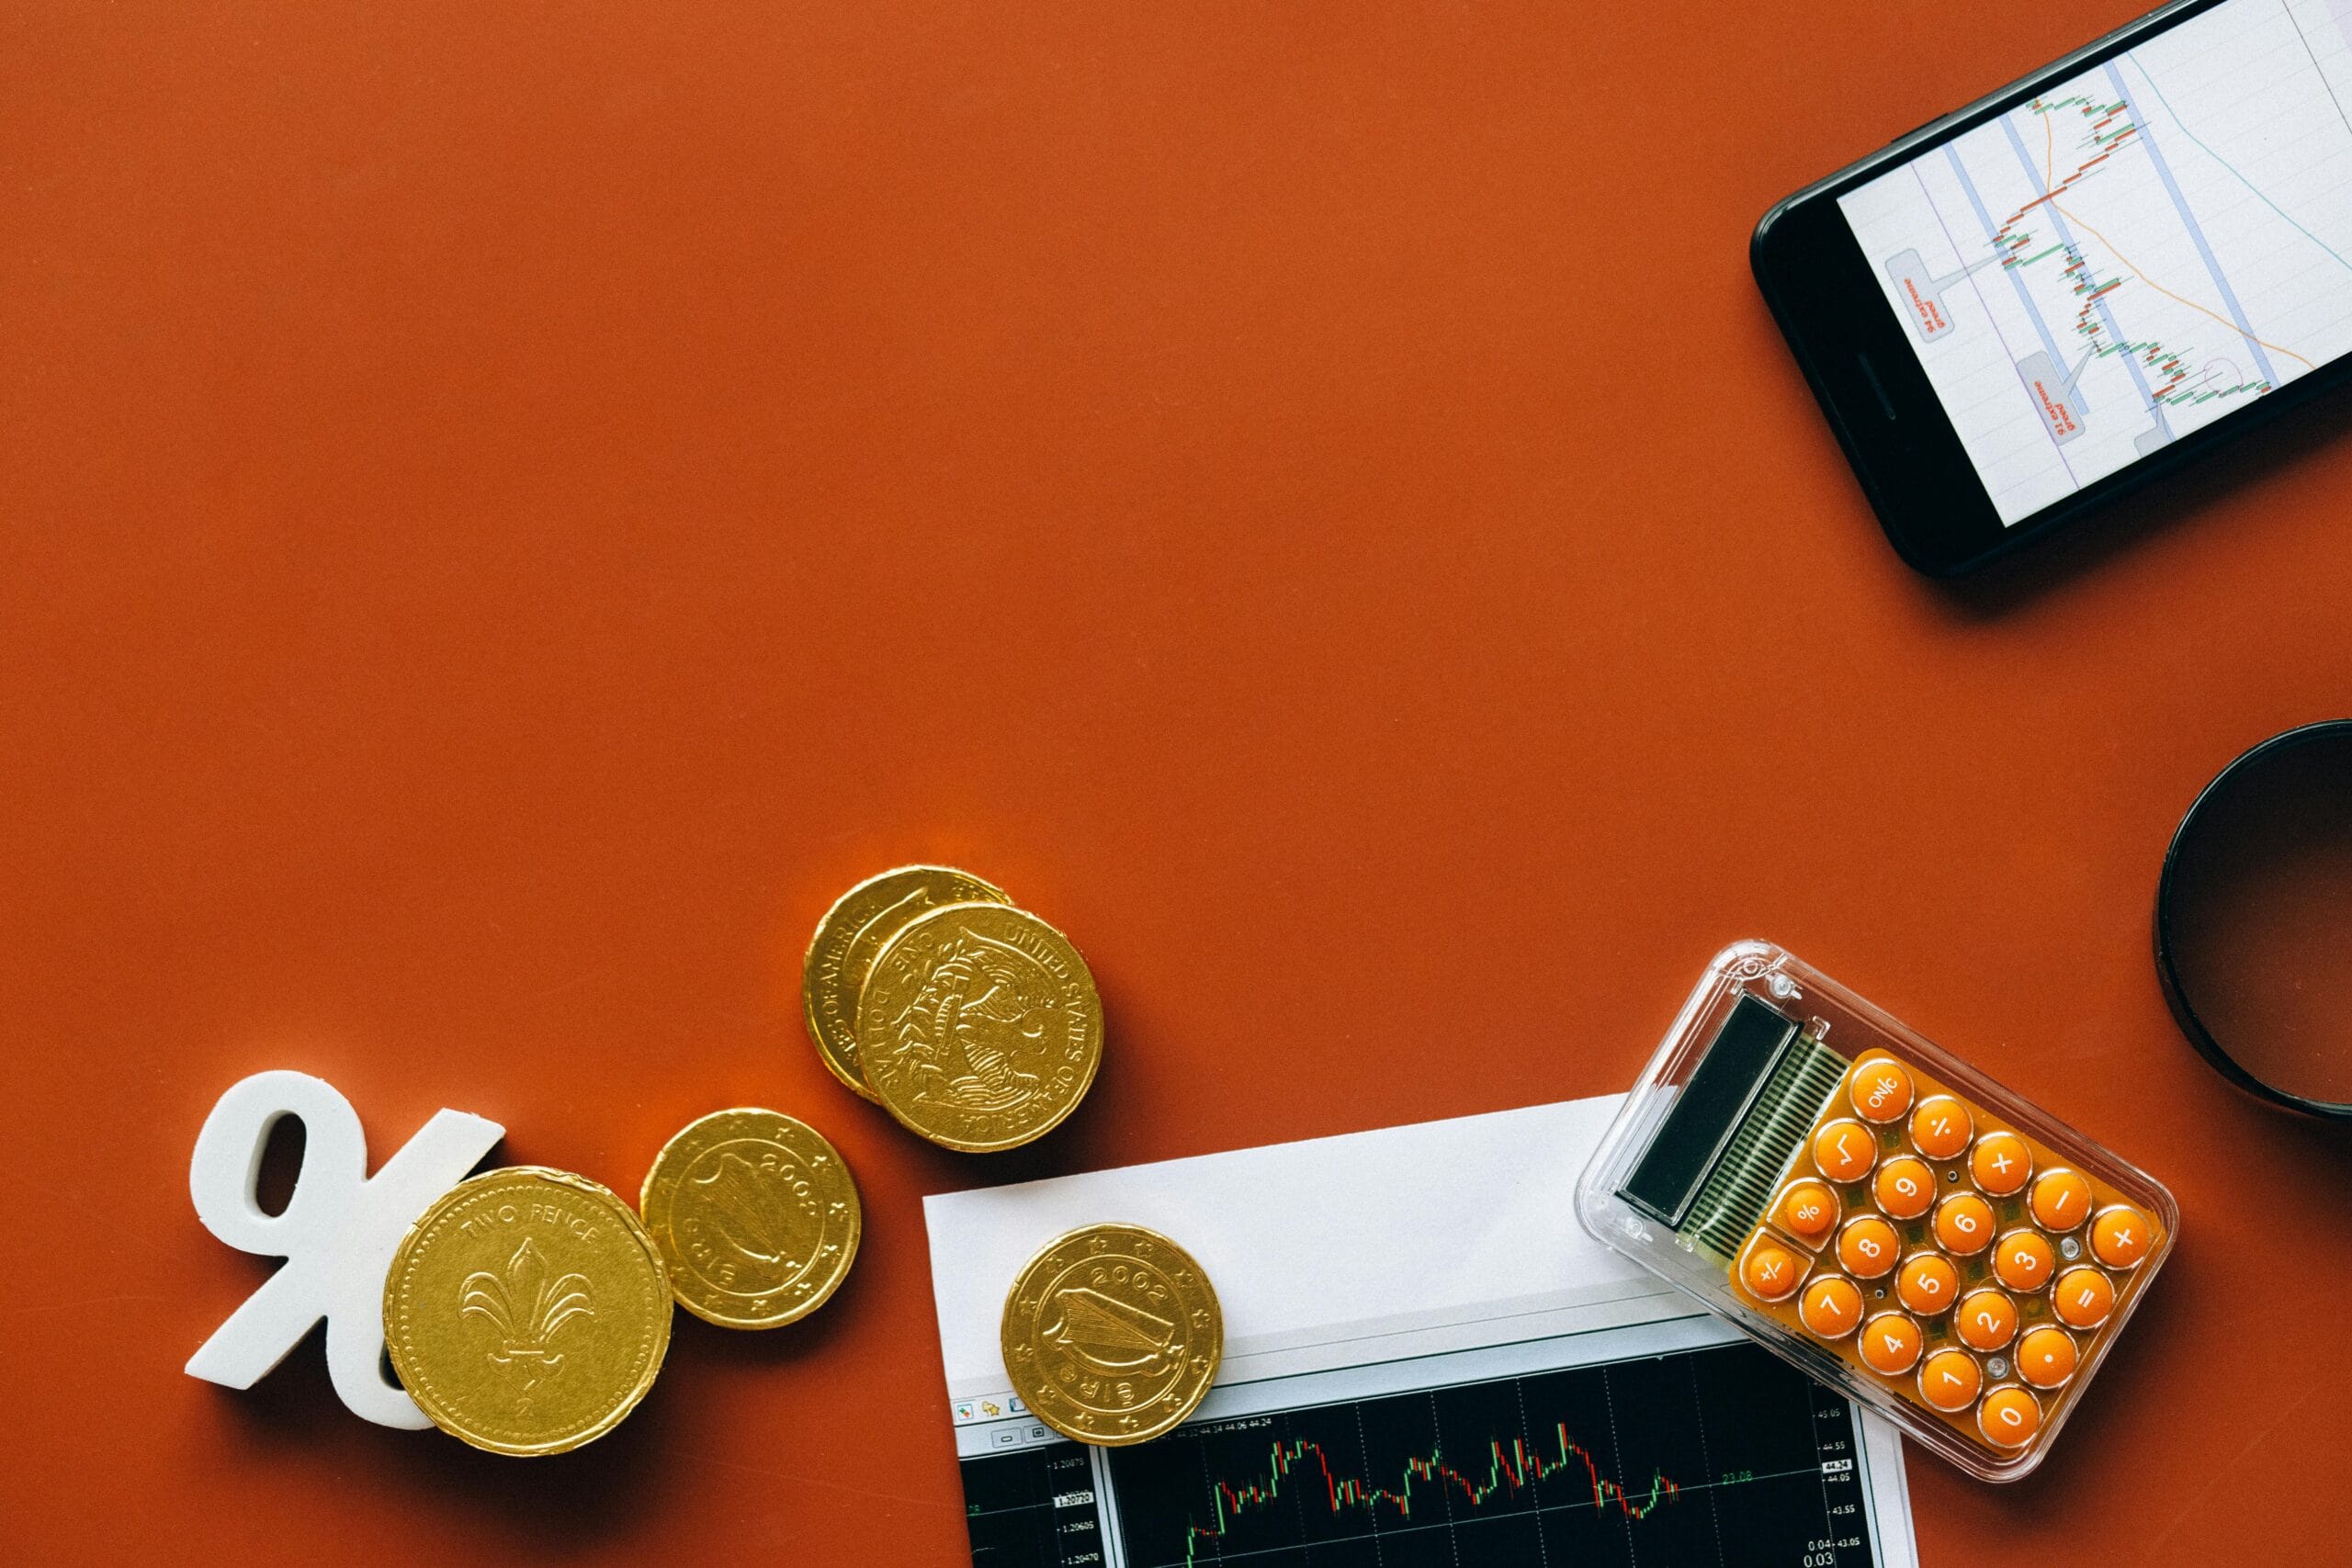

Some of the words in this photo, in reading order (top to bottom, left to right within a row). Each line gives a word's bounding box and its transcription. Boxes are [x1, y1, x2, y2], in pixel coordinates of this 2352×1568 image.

[1904, 278, 1928, 318] extreme
[1924, 299, 1946, 328] greed
[2034, 381, 2058, 421] extreme
[2055, 403, 2075, 431] greed
[2054, 423, 2065, 435] 91
[1004, 921, 1069, 980] UNITED
[1061, 982, 1089, 1063] STATES
[868, 988, 899, 1088] DOLLAR
[1053, 1066, 1074, 1095] OF
[1895, 1178, 1917, 1197] 9
[460, 1203, 517, 1239] TWO
[529, 1203, 601, 1243] PENCE
[1954, 1213, 1976, 1234] 6
[1858, 1238, 1881, 1258] 8
[2014, 1251, 2037, 1270] 3
[1091, 1266, 1169, 1306] 2002
[1917, 1273, 1940, 1294] 5
[1819, 1294, 1841, 1315] 7
[1977, 1312, 2000, 1333] 2
[1883, 1334, 1904, 1354] 4
[1942, 1371, 1962, 1386] 1
[1826, 1461, 1849, 1470] 44.24
[1827, 1472, 1850, 1482] 44.05
[1058, 1494, 1091, 1506] 1.20720
[1832, 1505, 1856, 1515] 43.55
[1063, 1521, 1094, 1533] 1.20605
[1808, 1540, 1831, 1551] 0.04
[1837, 1537, 1860, 1548] 43.05
[1804, 1551, 1834, 1568] 0.03
